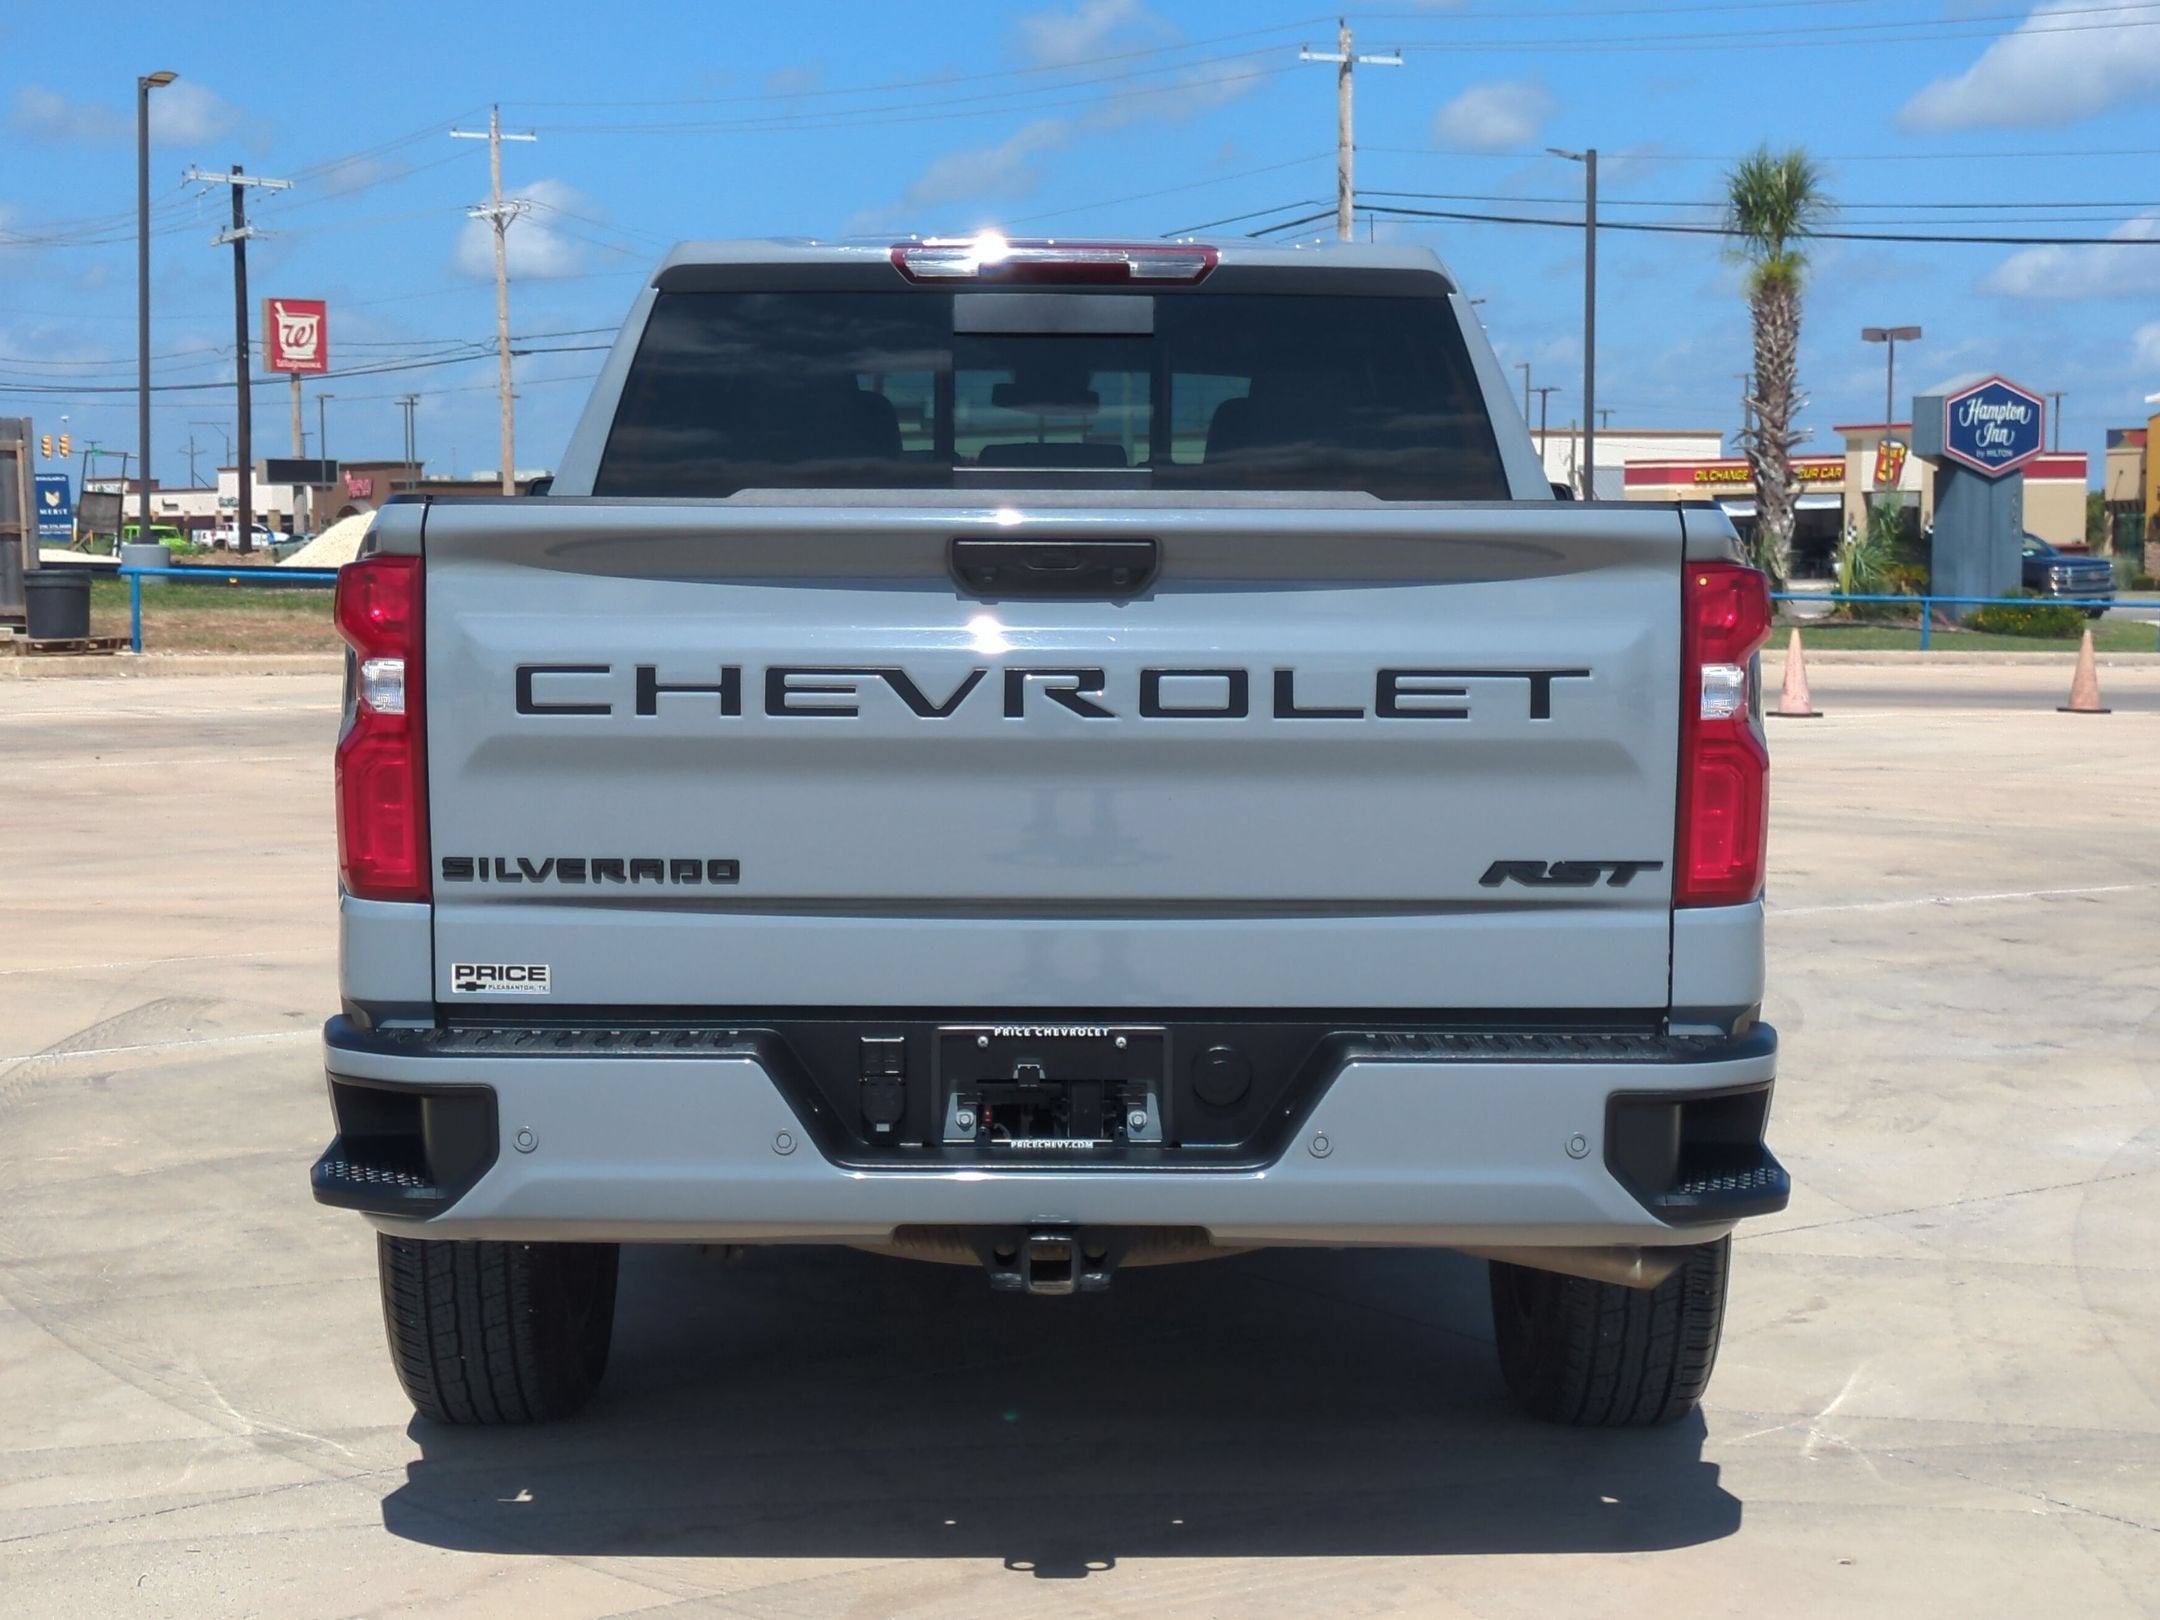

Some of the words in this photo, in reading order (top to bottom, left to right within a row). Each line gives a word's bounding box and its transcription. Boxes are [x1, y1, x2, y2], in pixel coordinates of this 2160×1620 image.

[1958, 397, 2032, 427] Hampton
[1975, 421, 2016, 447] Inn
[1986, 449, 2014, 458] HILTON
[1695, 470, 1709, 481] OIL
[1709, 469, 1749, 481] CHANGE
[1820, 466, 1843, 480] CAR
[515, 664, 1591, 720] CHEVROLET
[442, 856, 741, 884] SILVERADO
[1479, 860, 1664, 887] RST
[455, 965, 547, 981] PRICE
[994, 1026, 1031, 1037] PRICE
[1034, 1026, 1109, 1037] CHEVROLET
[1010, 1138, 1094, 1149] PRICECHEVY.COM
